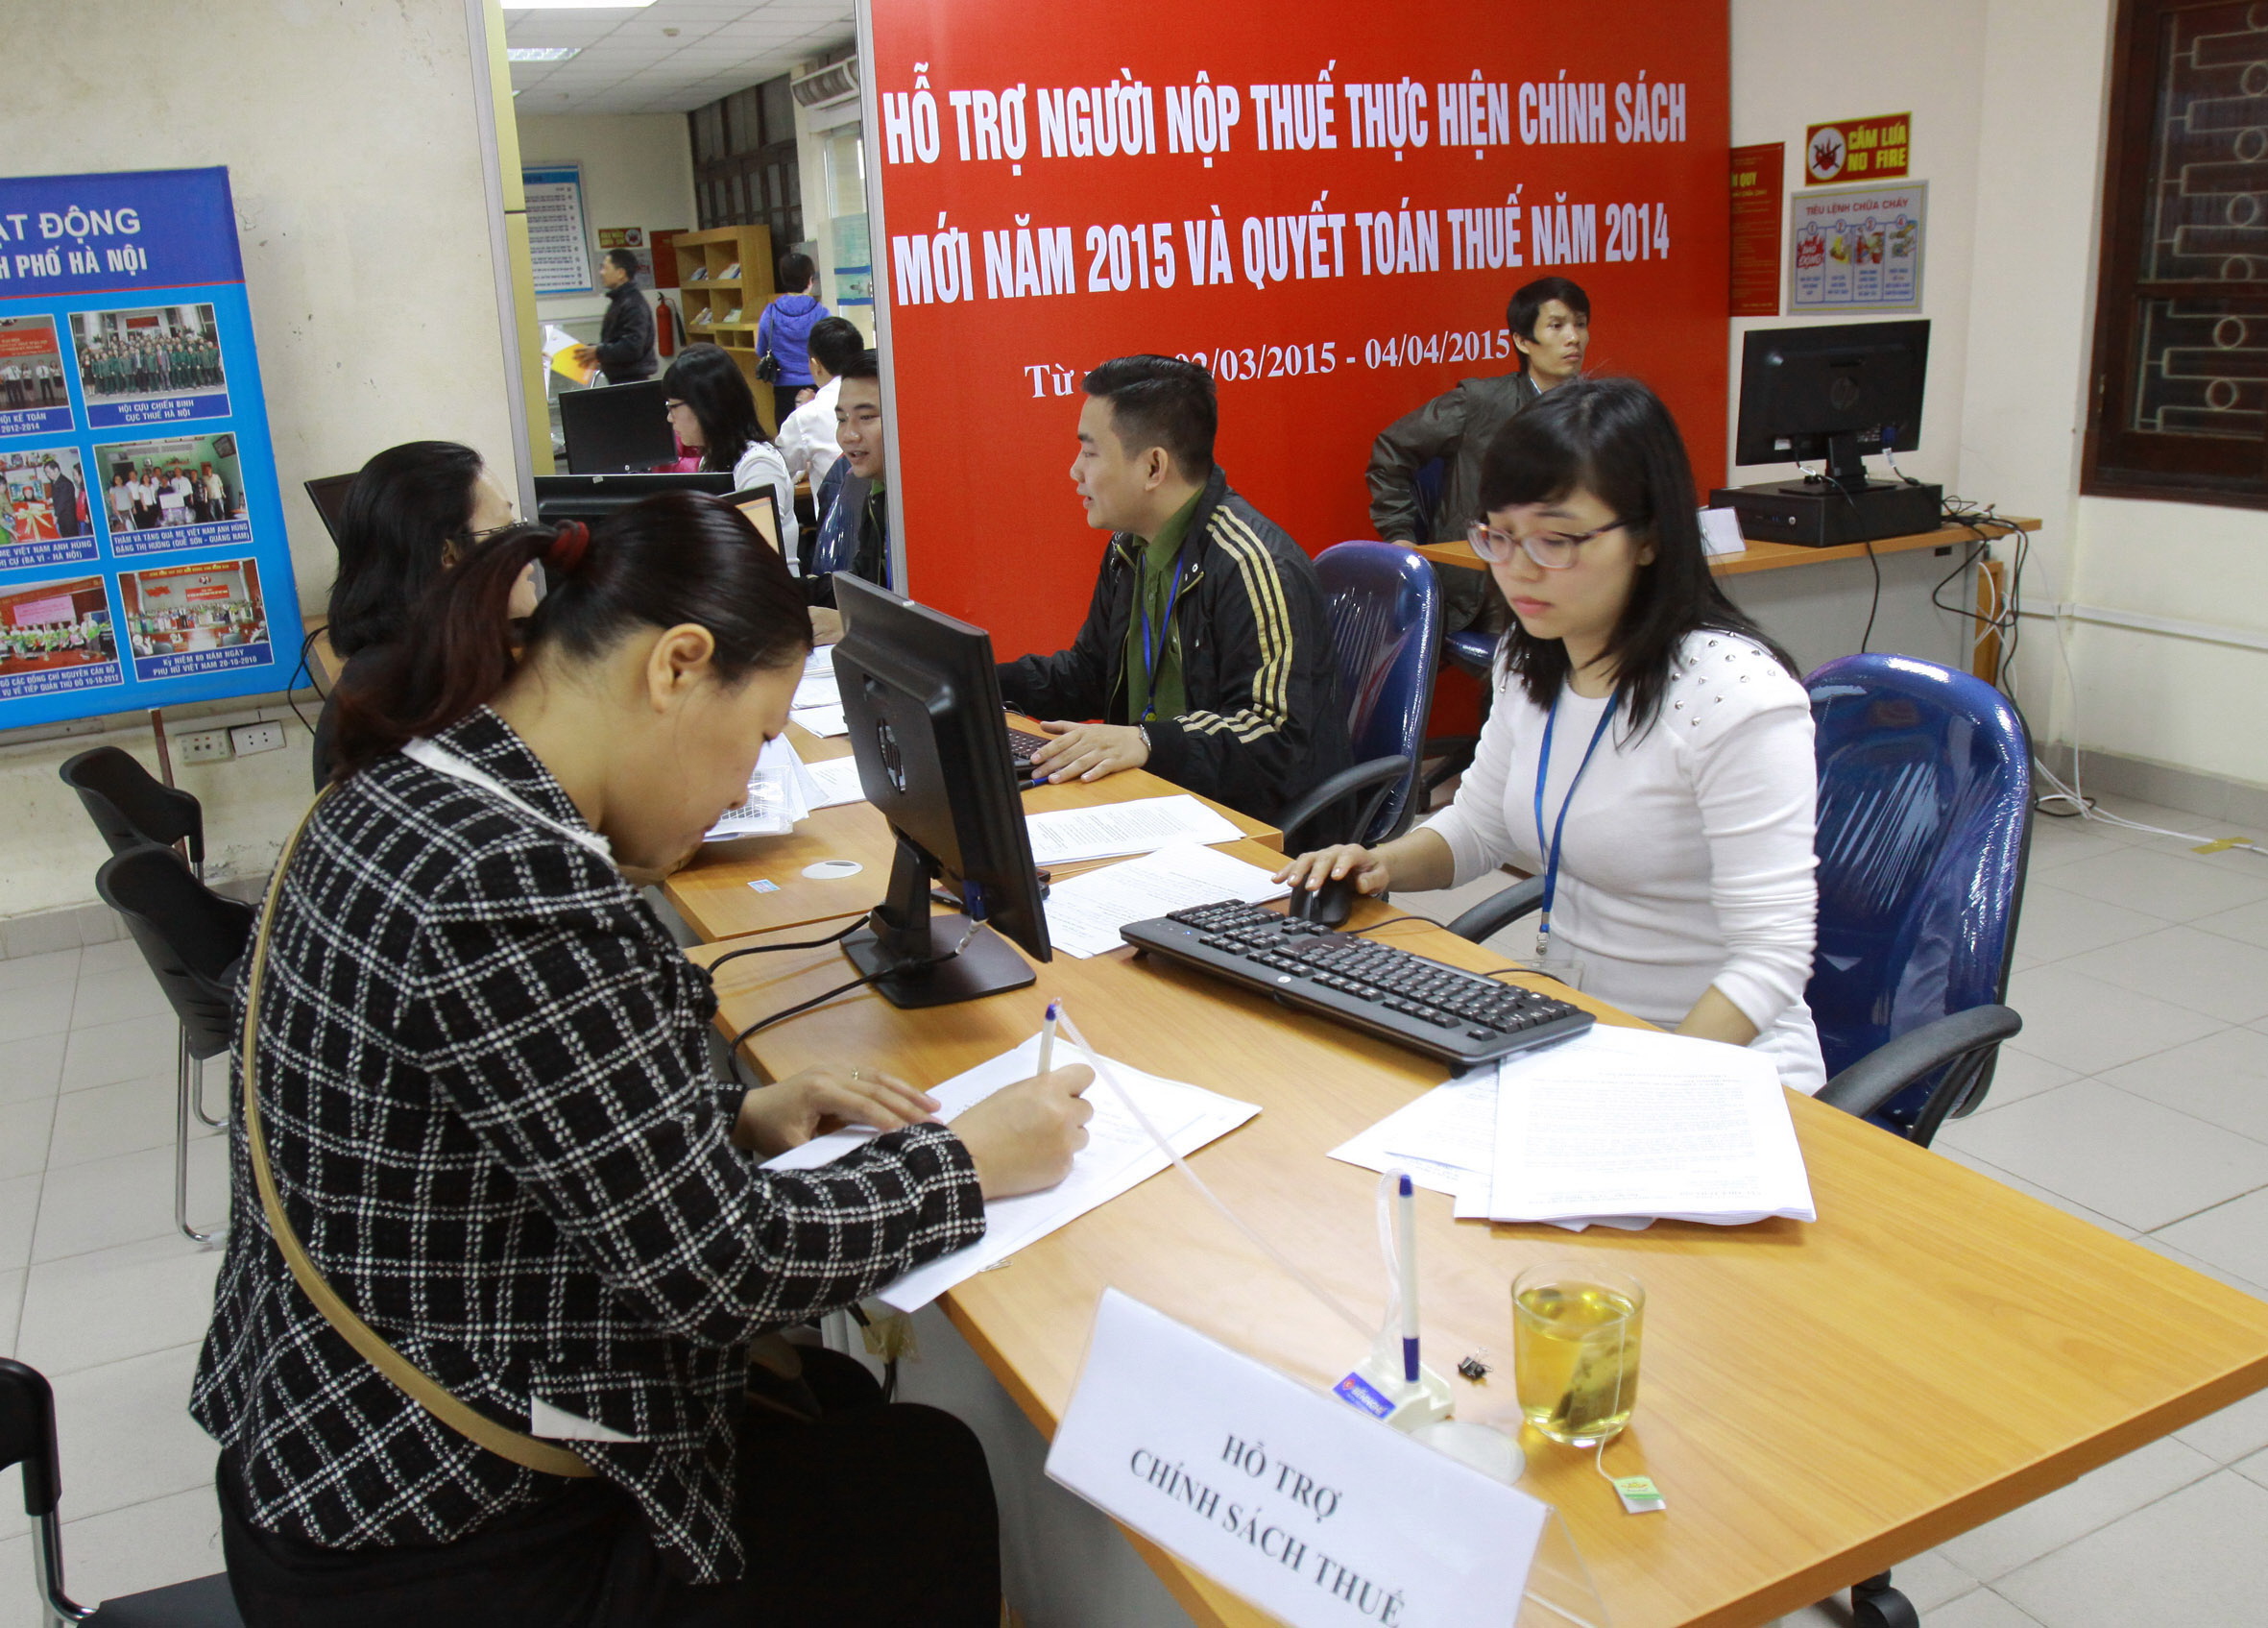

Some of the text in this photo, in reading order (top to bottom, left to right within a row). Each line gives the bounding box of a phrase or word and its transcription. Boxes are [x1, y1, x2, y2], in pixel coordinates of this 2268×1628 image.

[881, 59, 1687, 177] HỖ TRỢ NGƯỜI NỘP THUẾ THỰC HIỆN CHÍNH SÁCH
[1847, 148, 1907, 172] NO FIRE
[38, 205, 141, 244] ĐỘNG
[15, 245, 61, 279] PHỐ
[68, 246, 100, 275] HÀ
[107, 244, 147, 276] NỘI
[892, 210, 974, 306] MỚI
[982, 213, 1076, 300] NĂM
[1085, 222, 1175, 293] 2015
[1183, 205, 1234, 286] VÀ
[1242, 190, 1346, 290] QUYẾT
[1355, 196, 1439, 276] TOÁN
[1447, 183, 1524, 271] THUẾ
[1532, 190, 1598, 267] NĂM
[1604, 202, 1670, 263] 2014
[1024, 363, 1074, 399] Từ
[1174, 342, 1336, 382] /03/2015
[1365, 328, 1510, 370] 04/04/2015
[118, 402, 132, 413] HỘI
[176, 400, 194, 408] BINH
[1, 423, 40, 433] 2012-2014
[33, 544, 51, 554] NAM
[53, 543, 69, 551] ANH
[201, 661, 218, 671] NAM
[1221, 1434, 1343, 1524] HỖ TRỢ
[1129, 1448, 1407, 1628] CHÍNH SÁCH THUẾ
